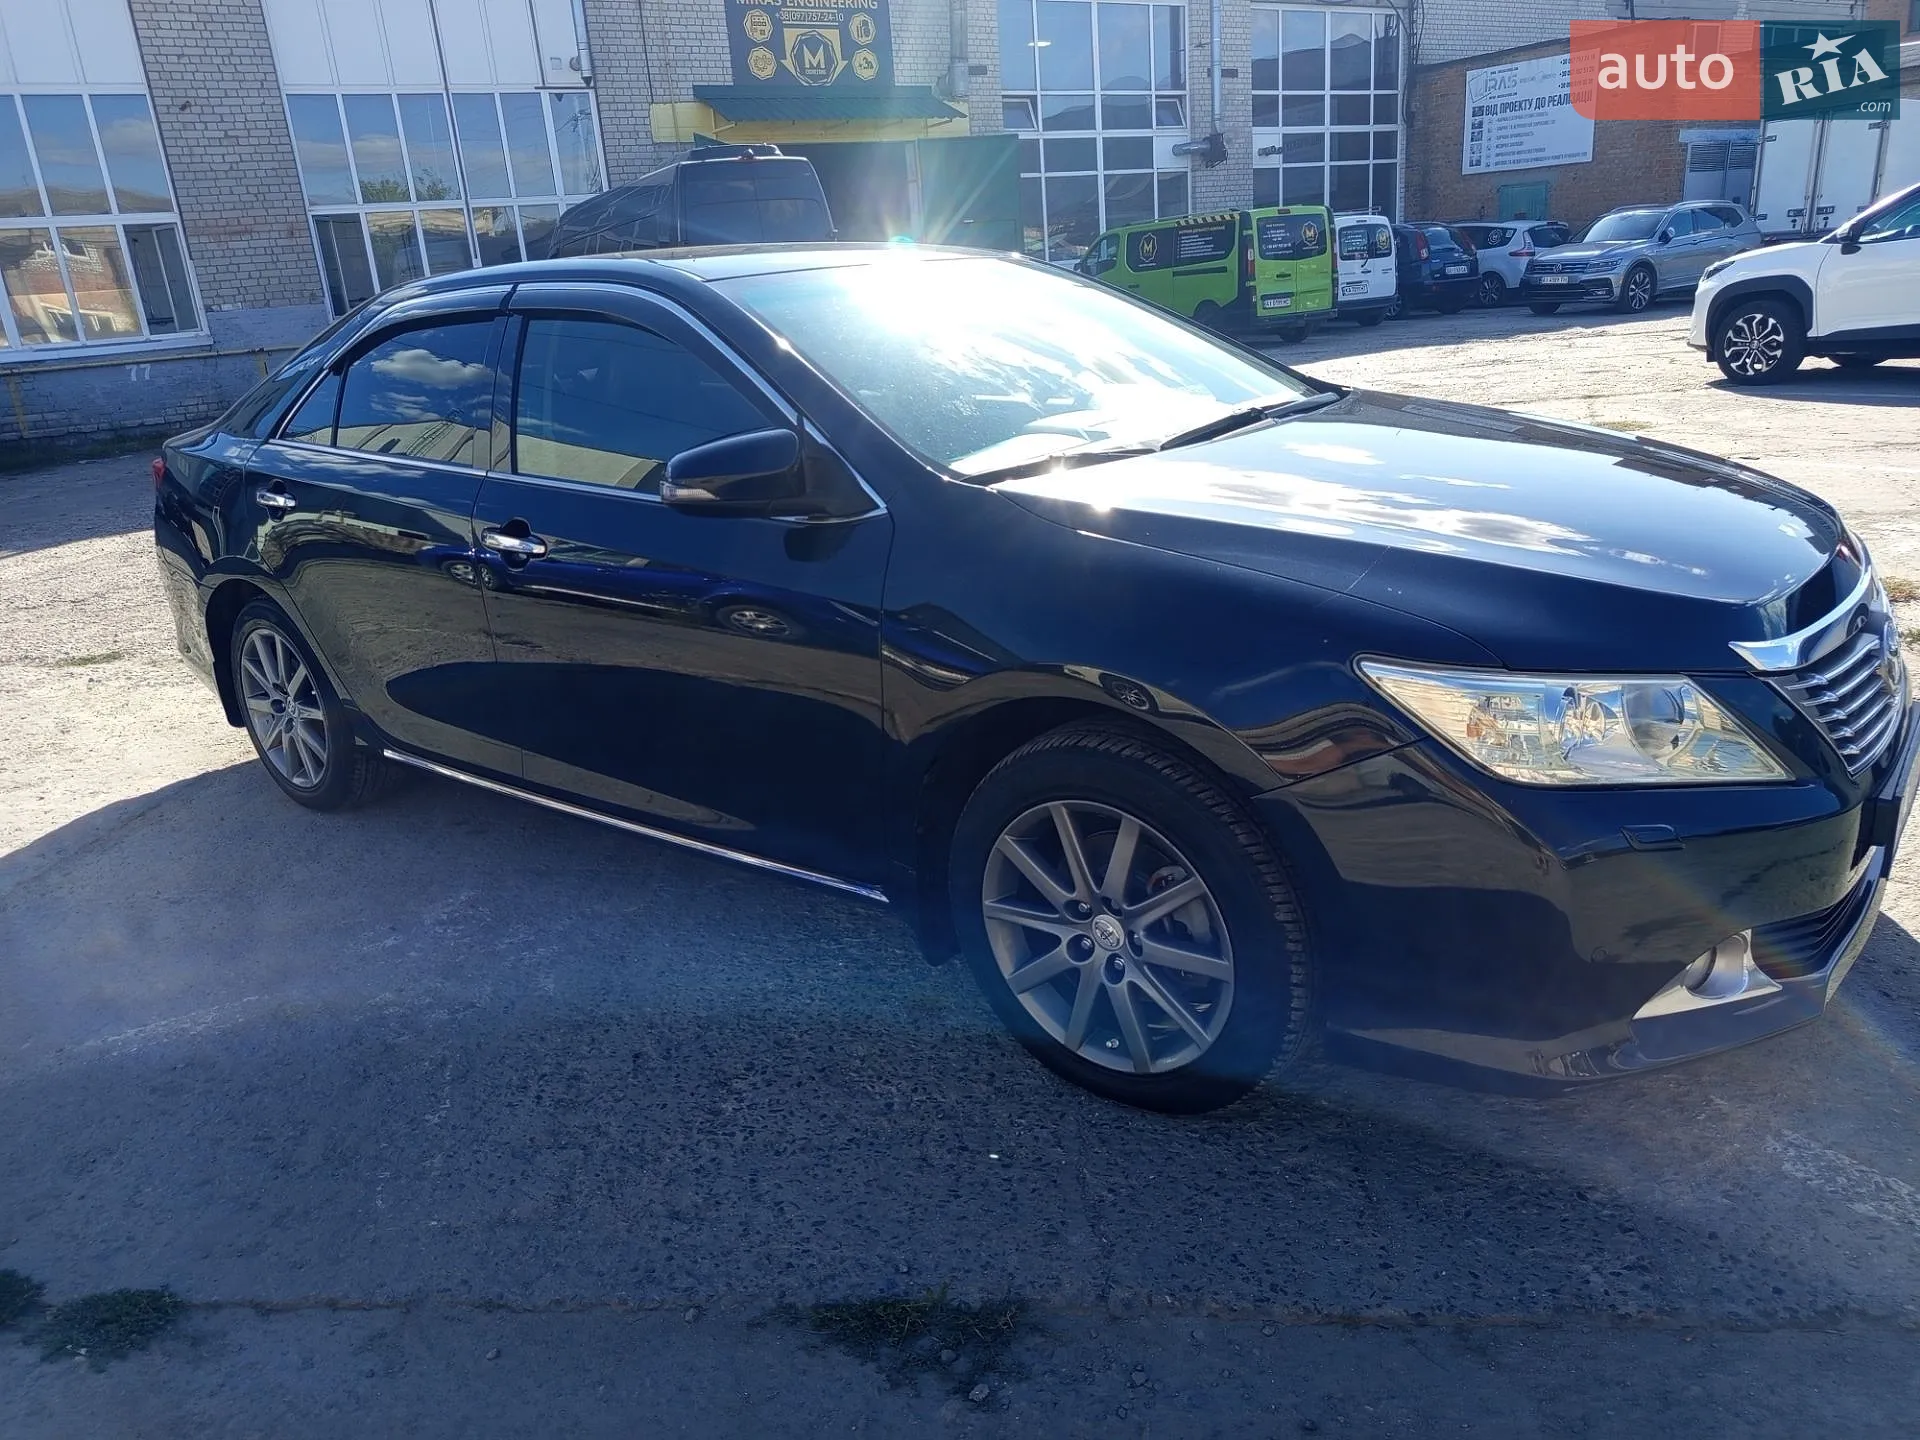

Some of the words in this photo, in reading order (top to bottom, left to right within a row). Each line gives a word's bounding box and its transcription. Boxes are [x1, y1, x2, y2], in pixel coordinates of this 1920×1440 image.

[786, 0, 878, 9] ENGINEERING
[803, 44, 826, 69] M
[1485, 104, 1498, 117] ВІД
[1499, 97, 1533, 113] ПРОЕКТУ
[1534, 96, 1546, 111] ДО
